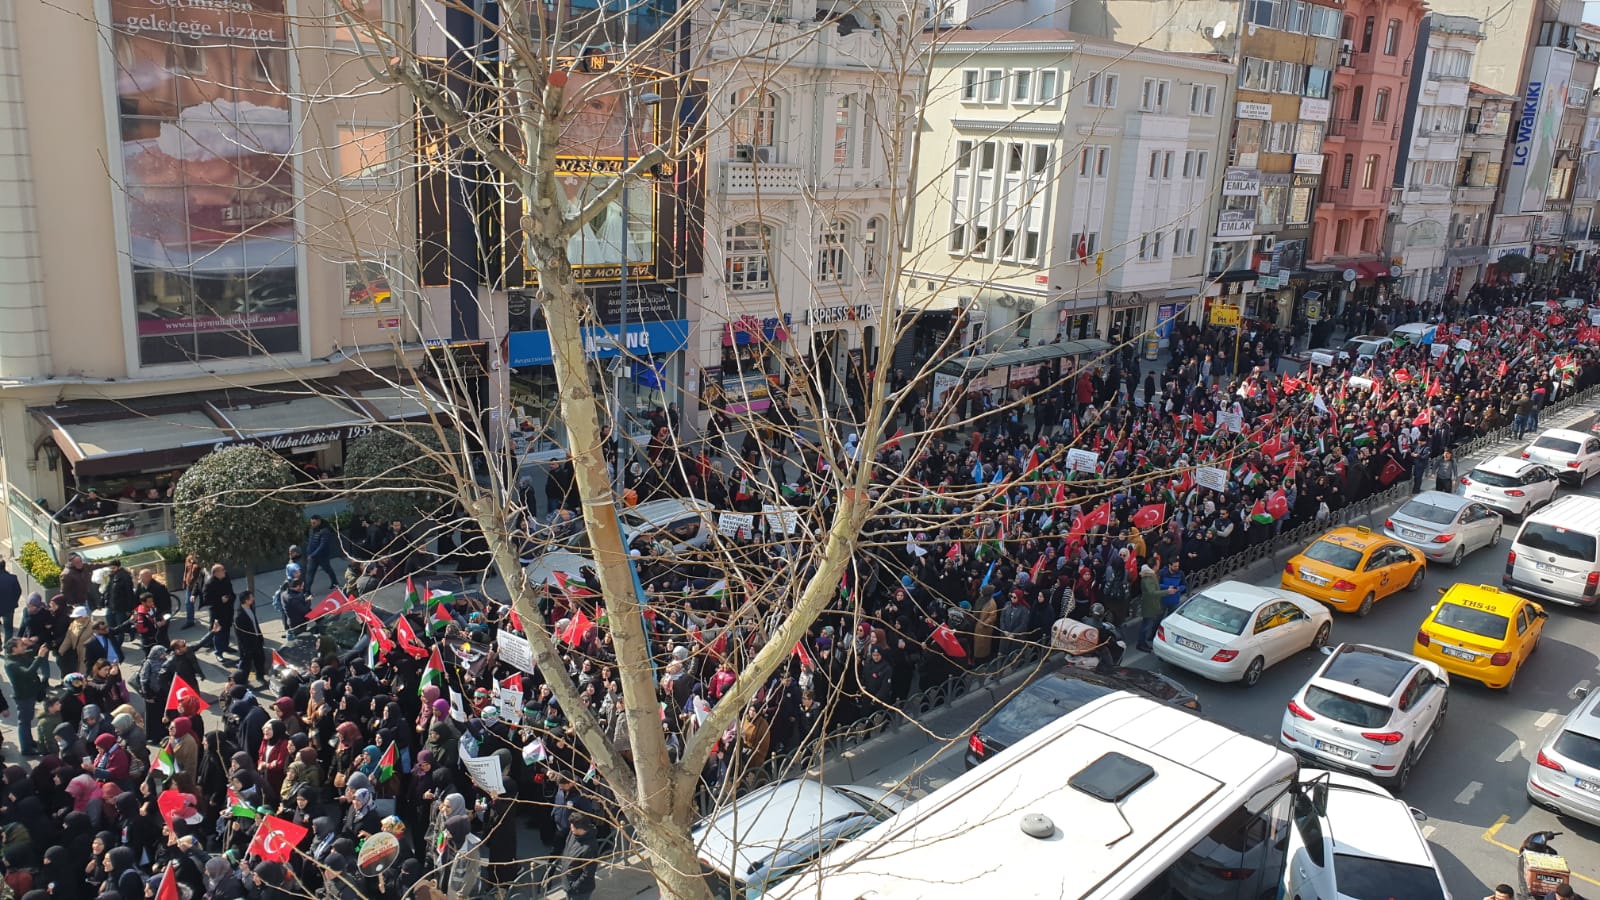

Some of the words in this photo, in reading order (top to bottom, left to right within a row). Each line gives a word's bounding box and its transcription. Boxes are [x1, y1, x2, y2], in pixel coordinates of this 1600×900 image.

[127, 14, 212, 39] geleceğe
[219, 21, 277, 42] lezzet
[1512, 146, 1528, 166] LC
[1226, 181, 1257, 191] EMLAK
[1221, 221, 1252, 231] EMLAK
[262, 430, 340, 451] Muhallebicisi
[347, 425, 373, 439] 1935
[1462, 599, 1483, 609] THS
[1485, 604, 1497, 612] 42
